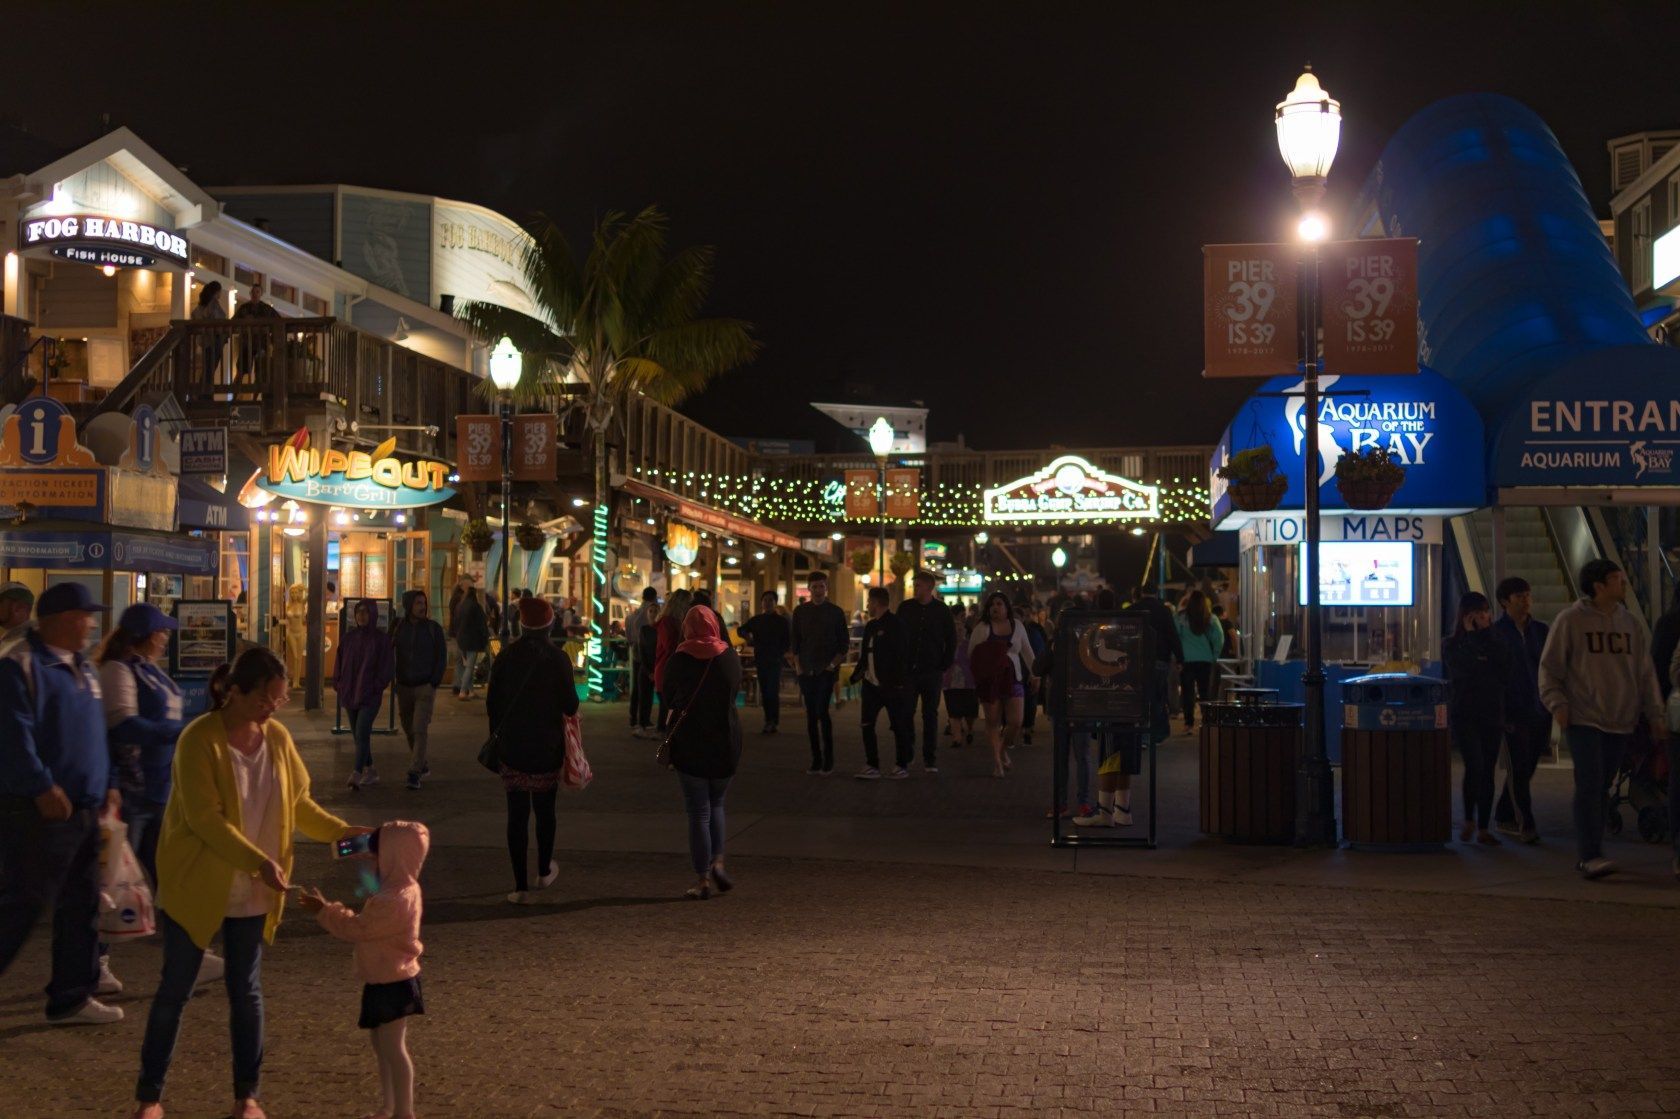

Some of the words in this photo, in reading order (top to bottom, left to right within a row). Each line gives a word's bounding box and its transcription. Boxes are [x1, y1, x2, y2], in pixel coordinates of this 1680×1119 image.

[28, 218, 80, 242] FOG
[84, 218, 188, 258] HARBOR
[67, 248, 96, 260] FISH
[101, 252, 143, 265] HOUSE
[1346, 255, 1394, 278] PIER
[1228, 260, 1275, 281] PIER
[1227, 281, 1276, 322] 39
[1345, 277, 1395, 319] 39
[1228, 323, 1247, 345] IS
[1249, 323, 1276, 345] 39
[1347, 321, 1366, 342] IS
[1369, 319, 1395, 342] 39
[1318, 398, 1435, 428] AQUARIUM
[468, 422, 492, 435] PIER
[524, 421, 547, 434] PIER
[1381, 420, 1399, 432] OF
[1400, 420, 1424, 432] THE
[182, 431, 224, 452] ATM
[468, 434, 493, 454] 39
[525, 433, 548, 454] 39
[1348, 428, 1434, 465] BAY
[268, 443, 450, 490] WIPEOUT
[468, 454, 479, 465] IS
[479, 454, 493, 465] 39
[525, 454, 535, 465] IS
[535, 453, 548, 465] 39
[1520, 452, 1621, 469] AQUARIUM
[1648, 457, 1672, 469] BAY
[206, 504, 228, 526] ATM
[1343, 517, 1424, 540] MAPS
[1584, 631, 1632, 655] UCI
